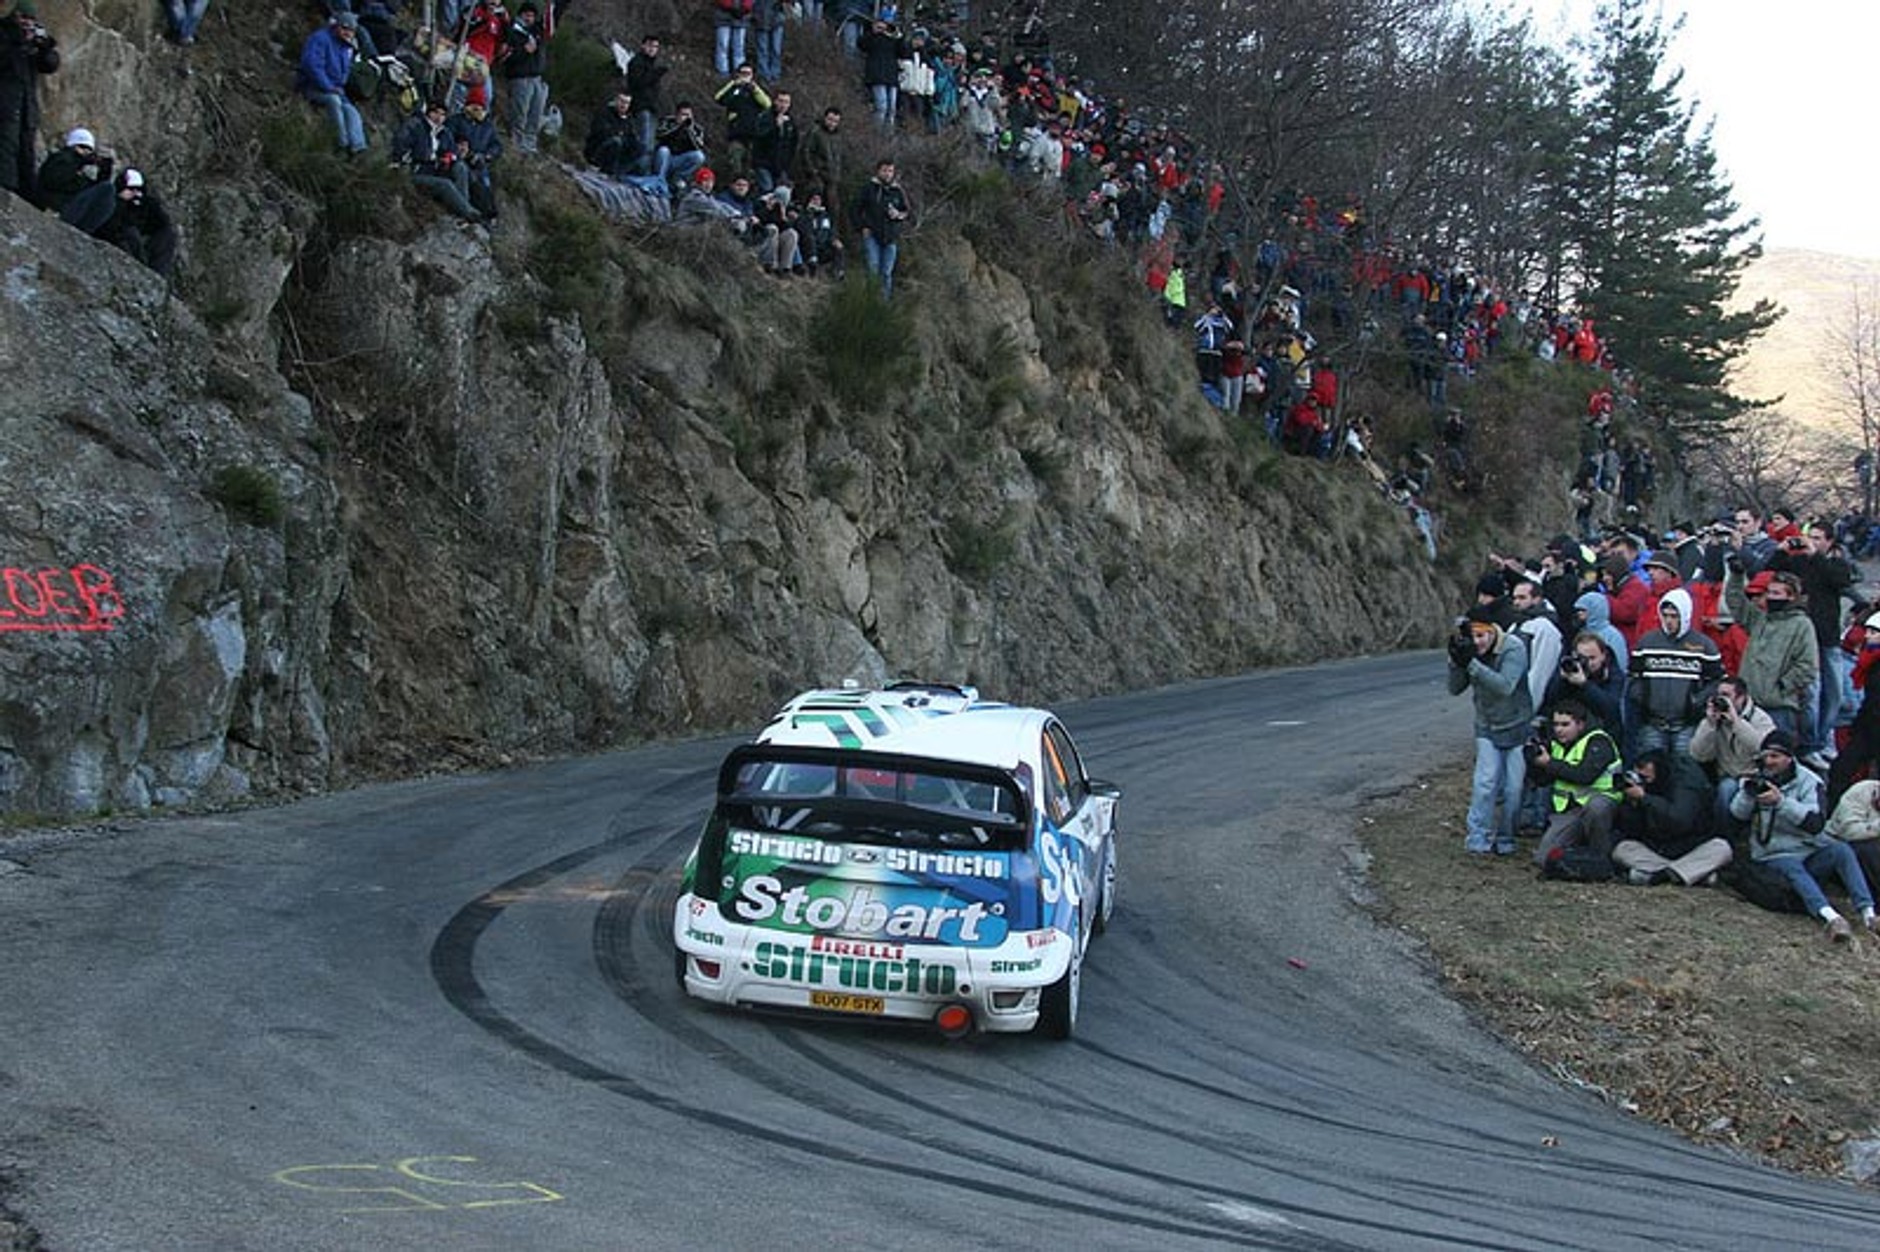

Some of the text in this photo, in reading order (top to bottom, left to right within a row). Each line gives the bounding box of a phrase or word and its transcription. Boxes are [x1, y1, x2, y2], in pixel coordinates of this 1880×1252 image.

[730, 832, 841, 864] Structo
[886, 848, 1002, 878] Structo
[735, 875, 988, 941] Stobart
[812, 936, 904, 959] PIRELLI
[753, 942, 956, 994] Structo
